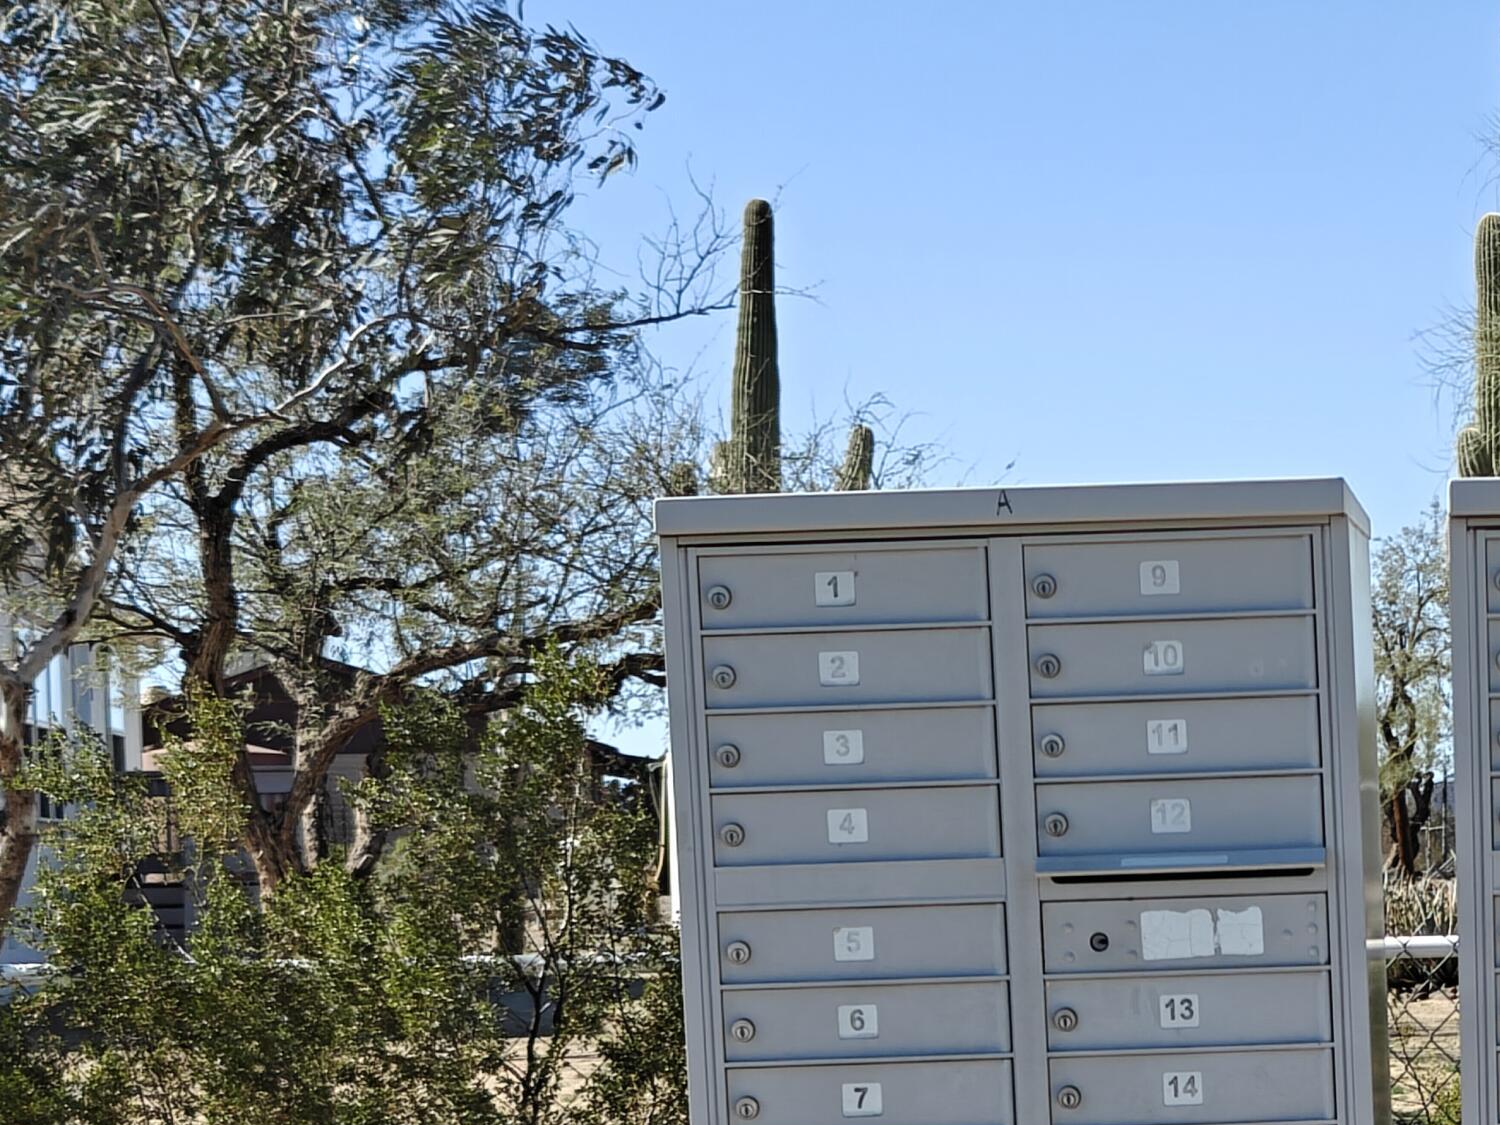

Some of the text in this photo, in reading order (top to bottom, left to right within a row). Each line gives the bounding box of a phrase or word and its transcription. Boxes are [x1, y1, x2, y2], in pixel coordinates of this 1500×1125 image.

[996, 489, 1013, 517] A
[827, 575, 839, 599] 1
[1151, 564, 1166, 588] 9
[831, 655, 847, 679] 2
[1148, 643, 1178, 668] 10
[834, 734, 849, 757] 3
[1151, 722, 1179, 747] 11
[839, 812, 855, 835] 4
[1156, 802, 1186, 826] 12
[846, 930, 861, 953] 5
[850, 1008, 865, 1032] 6
[1165, 998, 1195, 1021] 13
[854, 1087, 869, 1110] 7
[1168, 1075, 1199, 1099] 14
